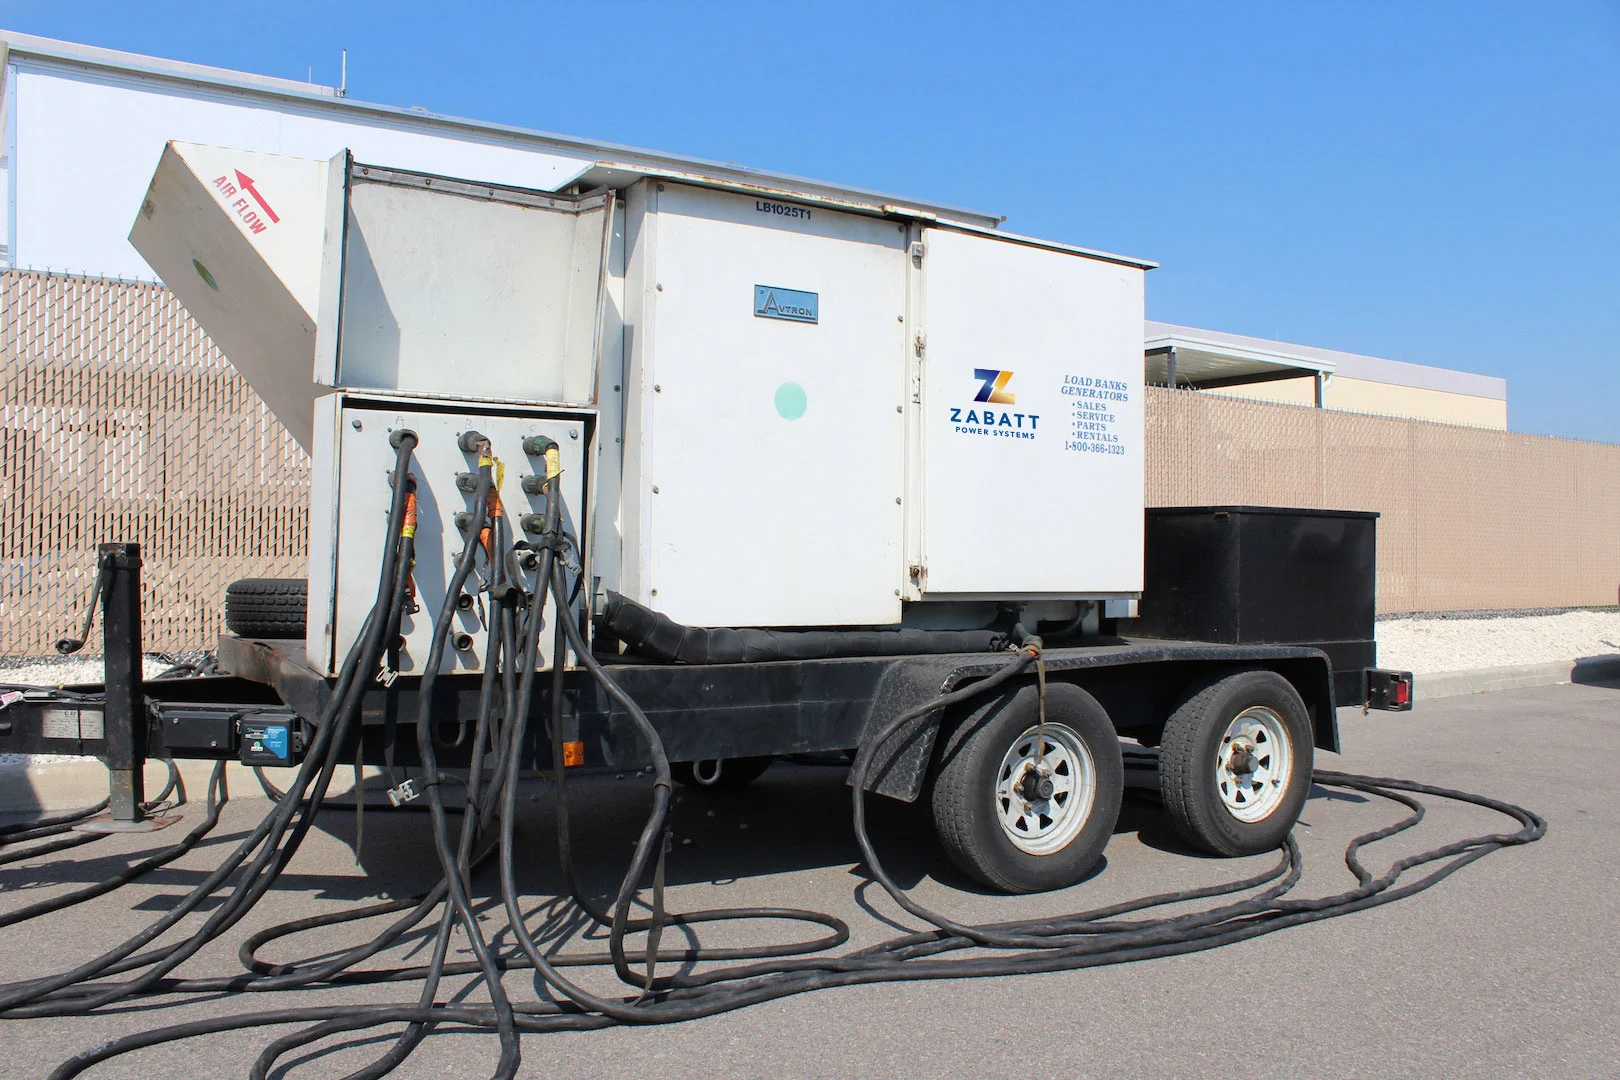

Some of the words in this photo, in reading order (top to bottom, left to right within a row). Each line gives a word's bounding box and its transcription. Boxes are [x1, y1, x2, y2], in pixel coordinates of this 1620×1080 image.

[212, 175, 237, 199] AIR
[232, 198, 267, 235] FLOW
[756, 201, 811, 220] LB1025T1
[757, 290, 814, 319] AVTRON
[1063, 374, 1093, 387] LOAD
[1094, 378, 1128, 391] BANKS
[1061, 385, 1128, 402] GENERATORS
[950, 407, 1040, 430] ZABATT
[955, 426, 990, 436] POWER
[993, 429, 1035, 440] SYSTEMS
